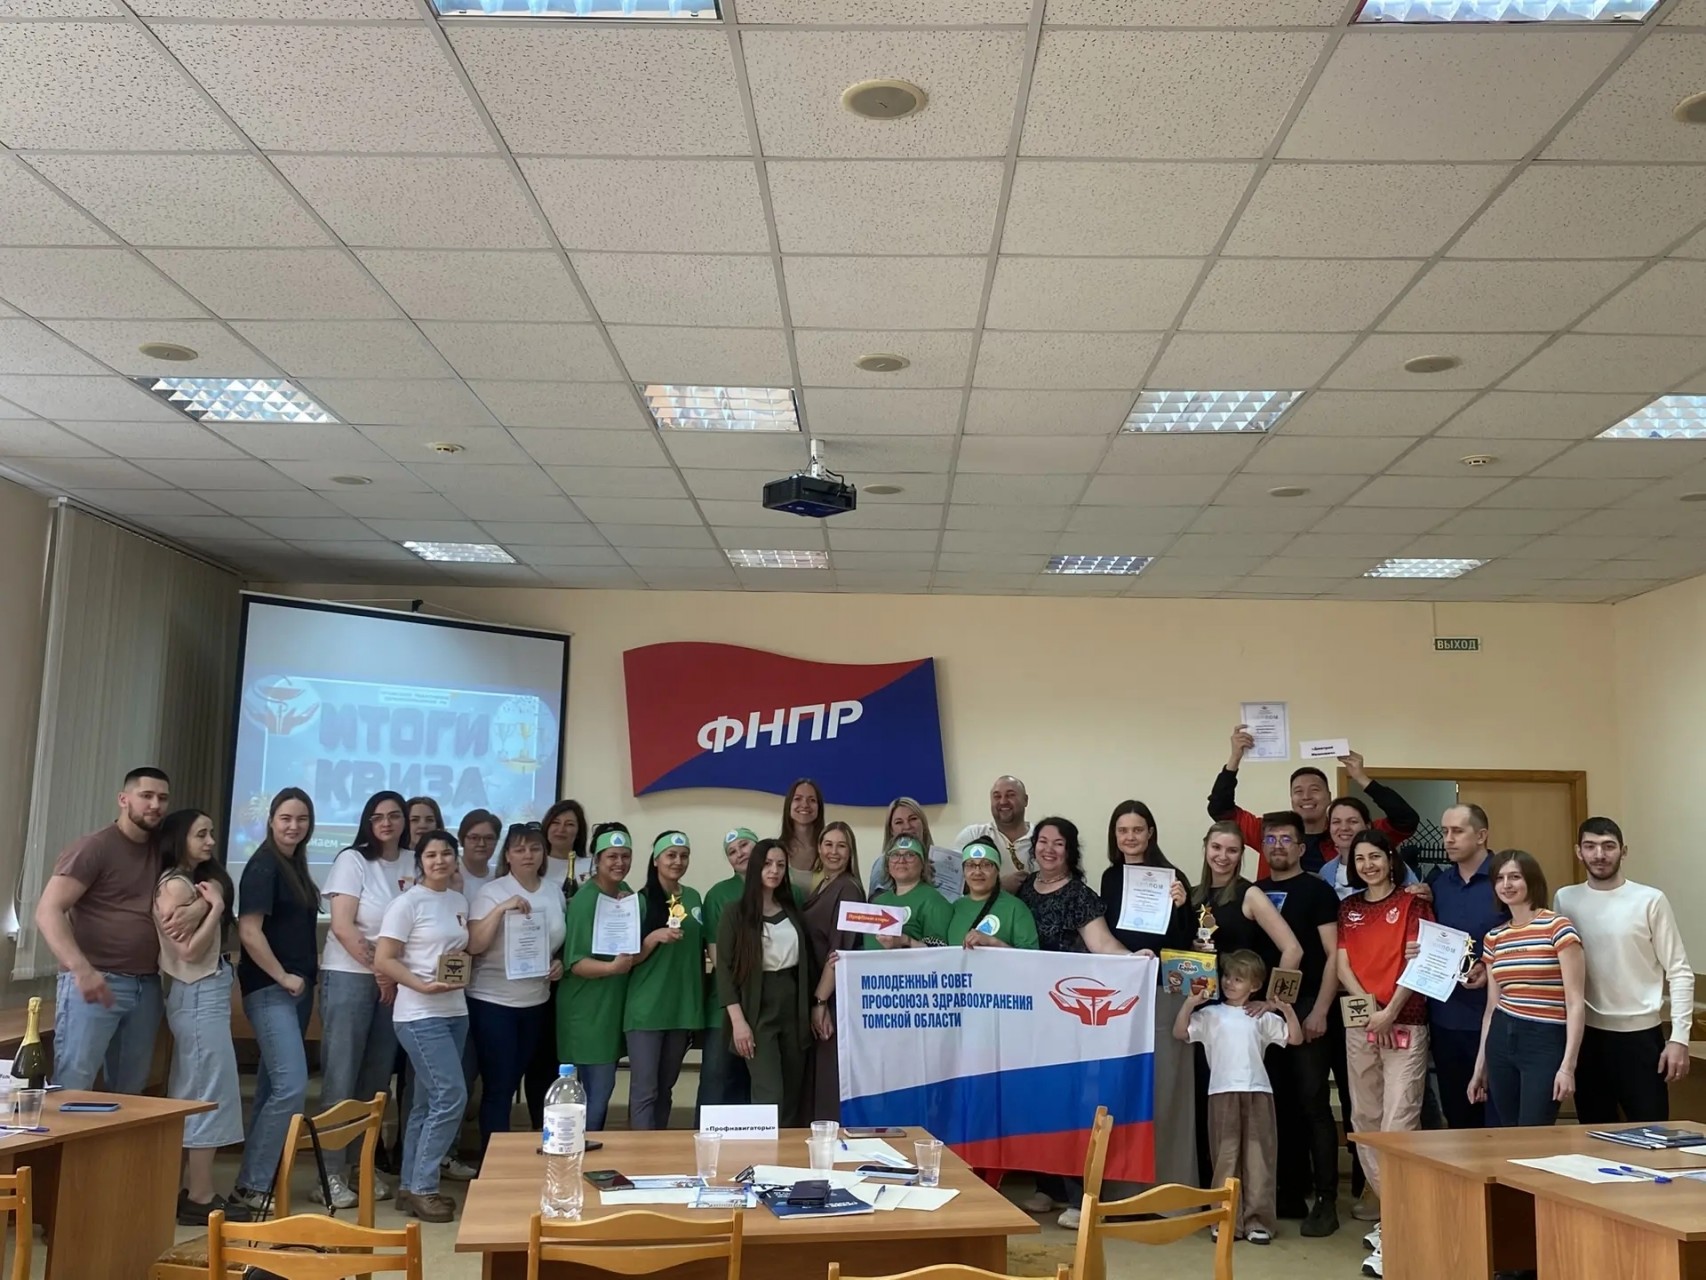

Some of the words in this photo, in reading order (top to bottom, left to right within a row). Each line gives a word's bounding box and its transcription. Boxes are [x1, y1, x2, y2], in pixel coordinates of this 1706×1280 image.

[1437, 640, 1476, 650] ВЫХОД
[319, 703, 492, 758] ИТОГИ
[697, 700, 863, 753] ФНПР
[314, 758, 490, 807] КВИЗА
[861, 971, 938, 991] МОЛОДЕЖНЫЙ
[941, 973, 973, 989] СОВЕТ
[862, 993, 930, 1009] ПРОФСОЮЗА
[932, 993, 1033, 1010] ЗДРАВООХРАНЕНИЯ
[862, 1011, 911, 1029] ТОМСКОЙ
[914, 1012, 962, 1028] ОБЛАСТИ
